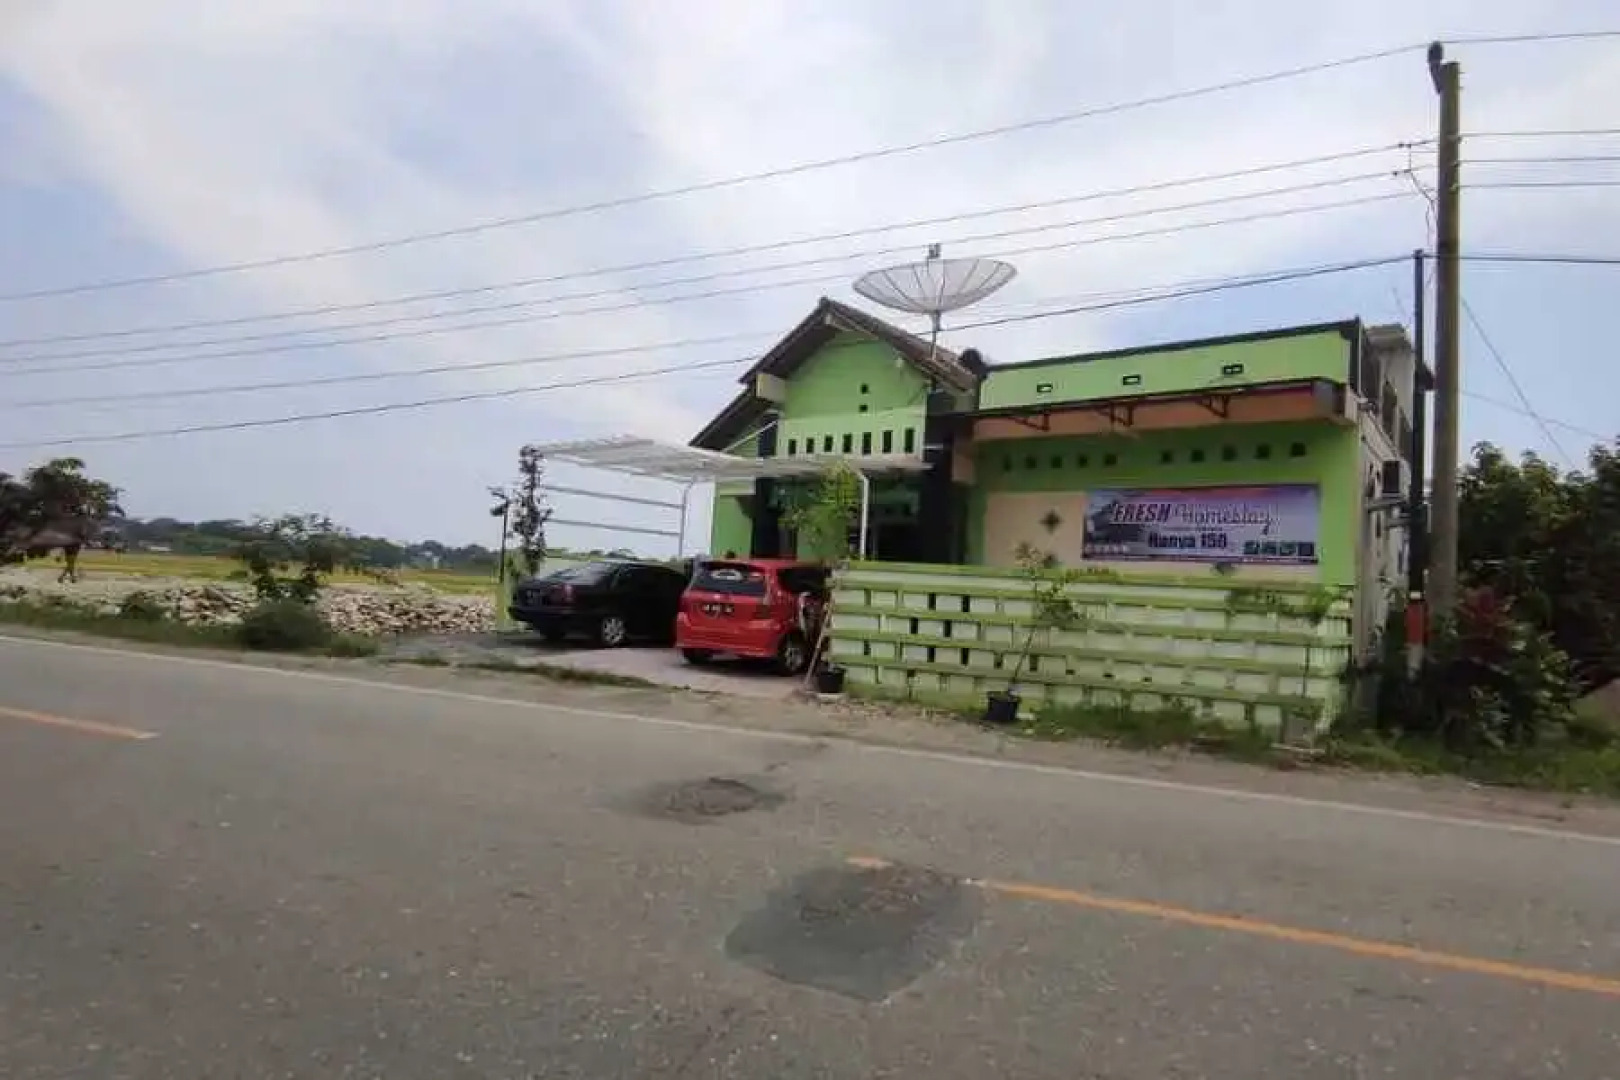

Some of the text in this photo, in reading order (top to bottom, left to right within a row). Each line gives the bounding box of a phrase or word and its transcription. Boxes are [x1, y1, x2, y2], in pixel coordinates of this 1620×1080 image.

[1113, 503, 1171, 523] FRESH
[1148, 531, 1196, 549] Hanya
[1201, 531, 1228, 549] 150
